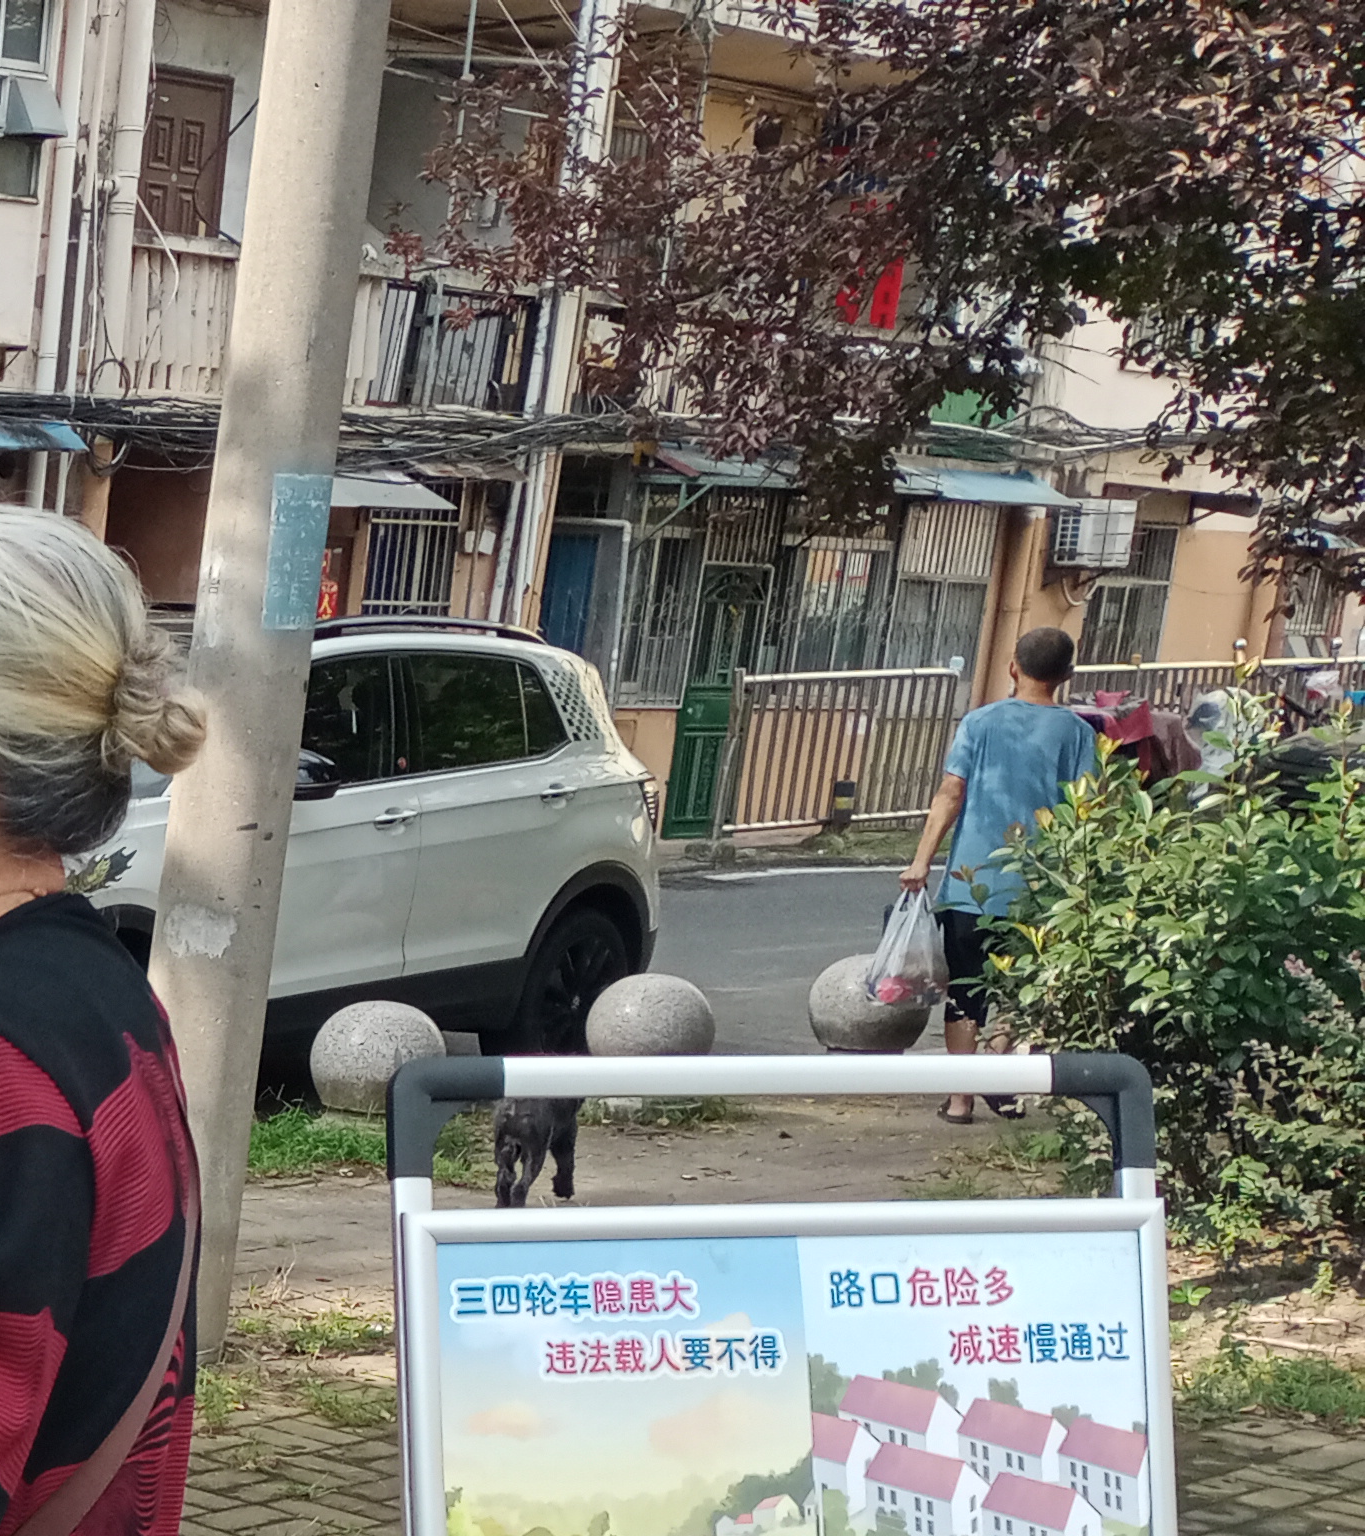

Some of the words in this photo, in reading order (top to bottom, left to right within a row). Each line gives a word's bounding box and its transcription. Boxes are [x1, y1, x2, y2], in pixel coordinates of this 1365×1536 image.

[456, 1278, 695, 1317] 三四轮车隐患大
[830, 1266, 1015, 1309] 路口危险多
[545, 1334, 782, 1375] 违法载人要不得
[949, 1321, 1130, 1365] 减速慢通过
